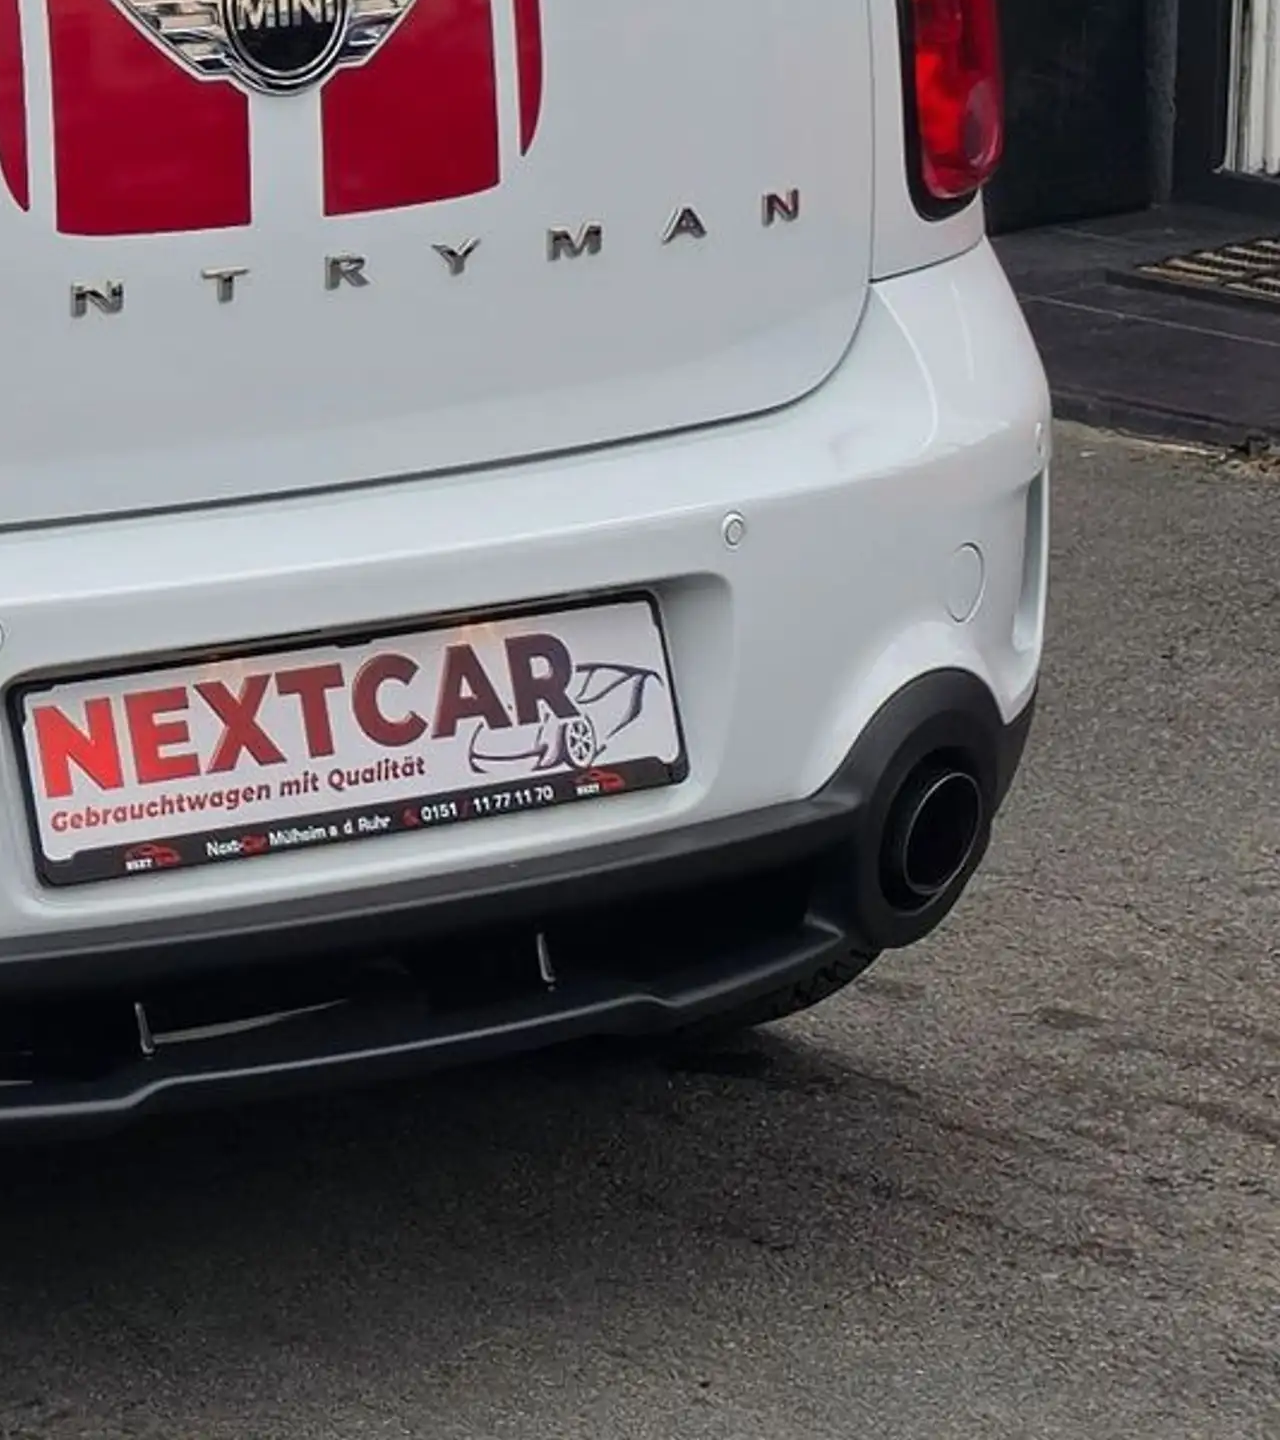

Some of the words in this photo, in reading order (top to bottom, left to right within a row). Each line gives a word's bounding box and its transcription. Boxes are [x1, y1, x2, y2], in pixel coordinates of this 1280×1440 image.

[32, 632, 583, 799] NEXTCAR
[51, 782, 272, 834] Gebrauchtwagen
[279, 770, 320, 800] mit
[327, 757, 426, 792] Qualität
[420, 802, 458, 821] 0151
[473, 796, 491, 811] 11
[492, 793, 511, 808] 77
[515, 790, 532, 805] 11
[535, 785, 554, 801] 70
